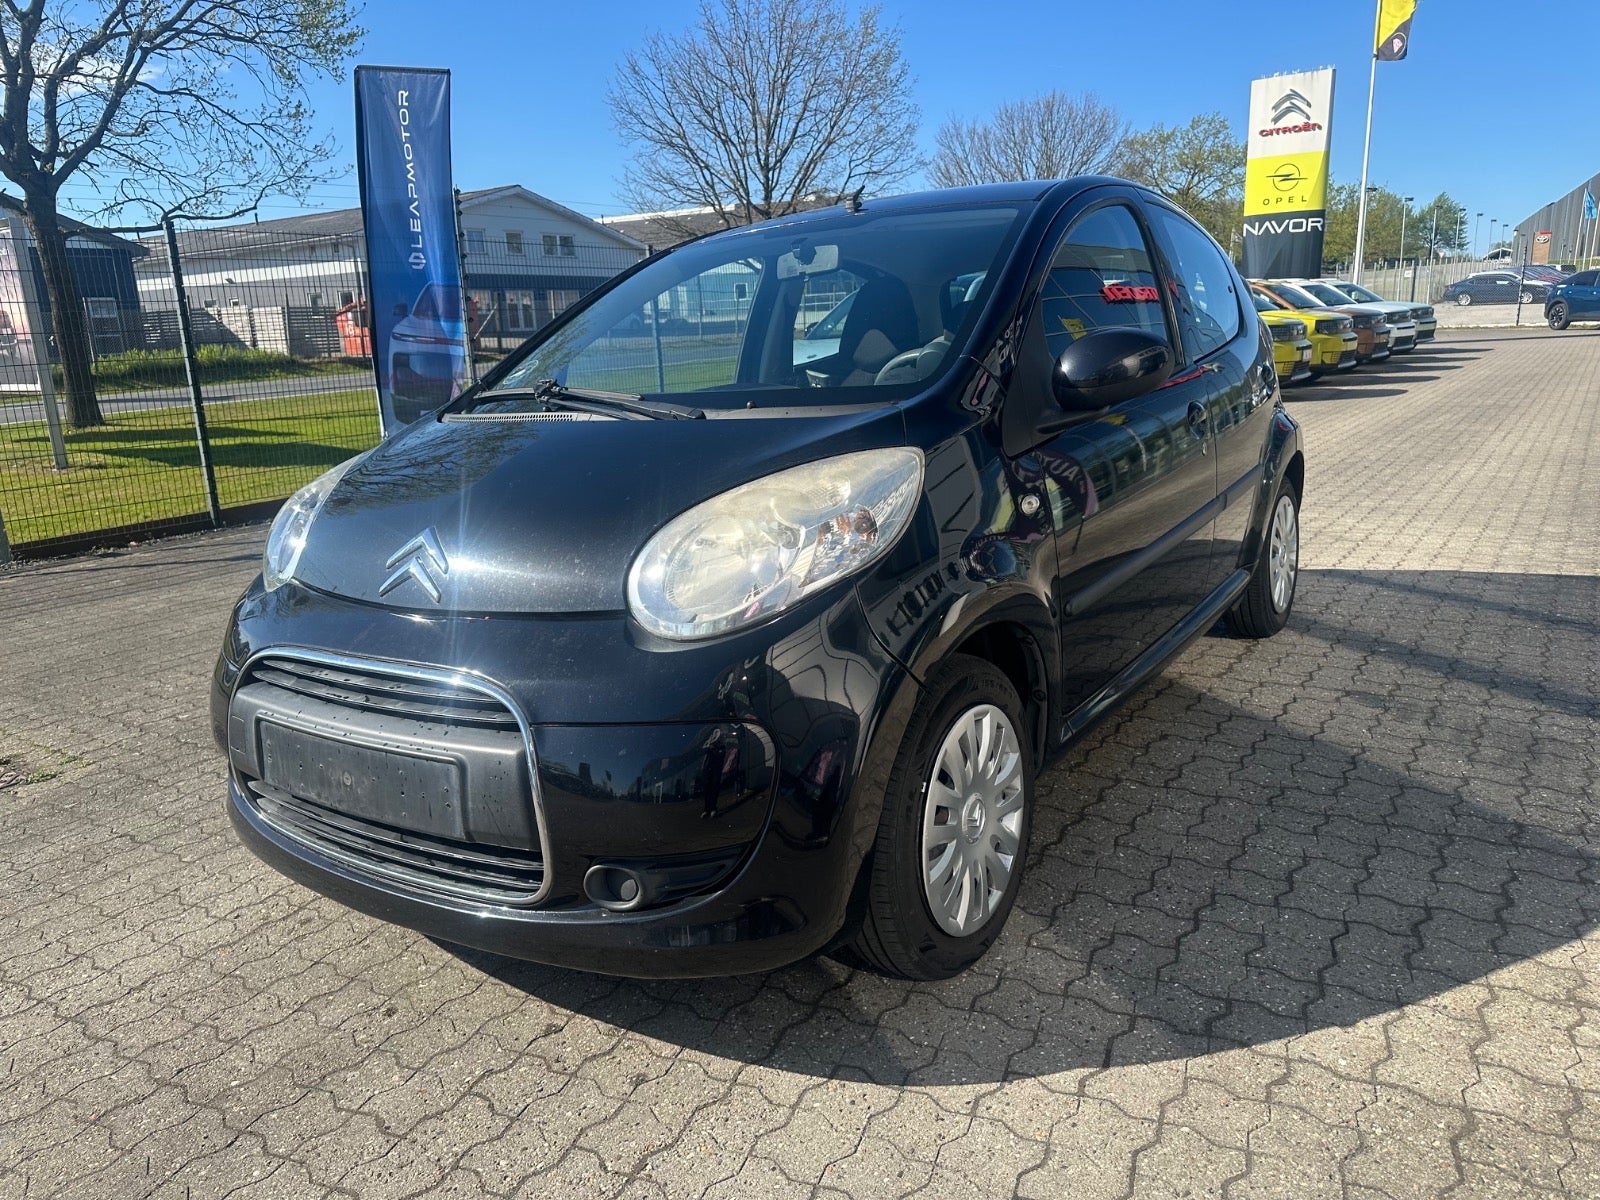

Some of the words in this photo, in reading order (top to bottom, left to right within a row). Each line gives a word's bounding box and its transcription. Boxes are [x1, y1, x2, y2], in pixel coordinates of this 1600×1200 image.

[398, 90, 422, 249] LEAPMOTOR
[1262, 194, 1308, 206] OPEL
[1242, 217, 1324, 237] NAVOR
